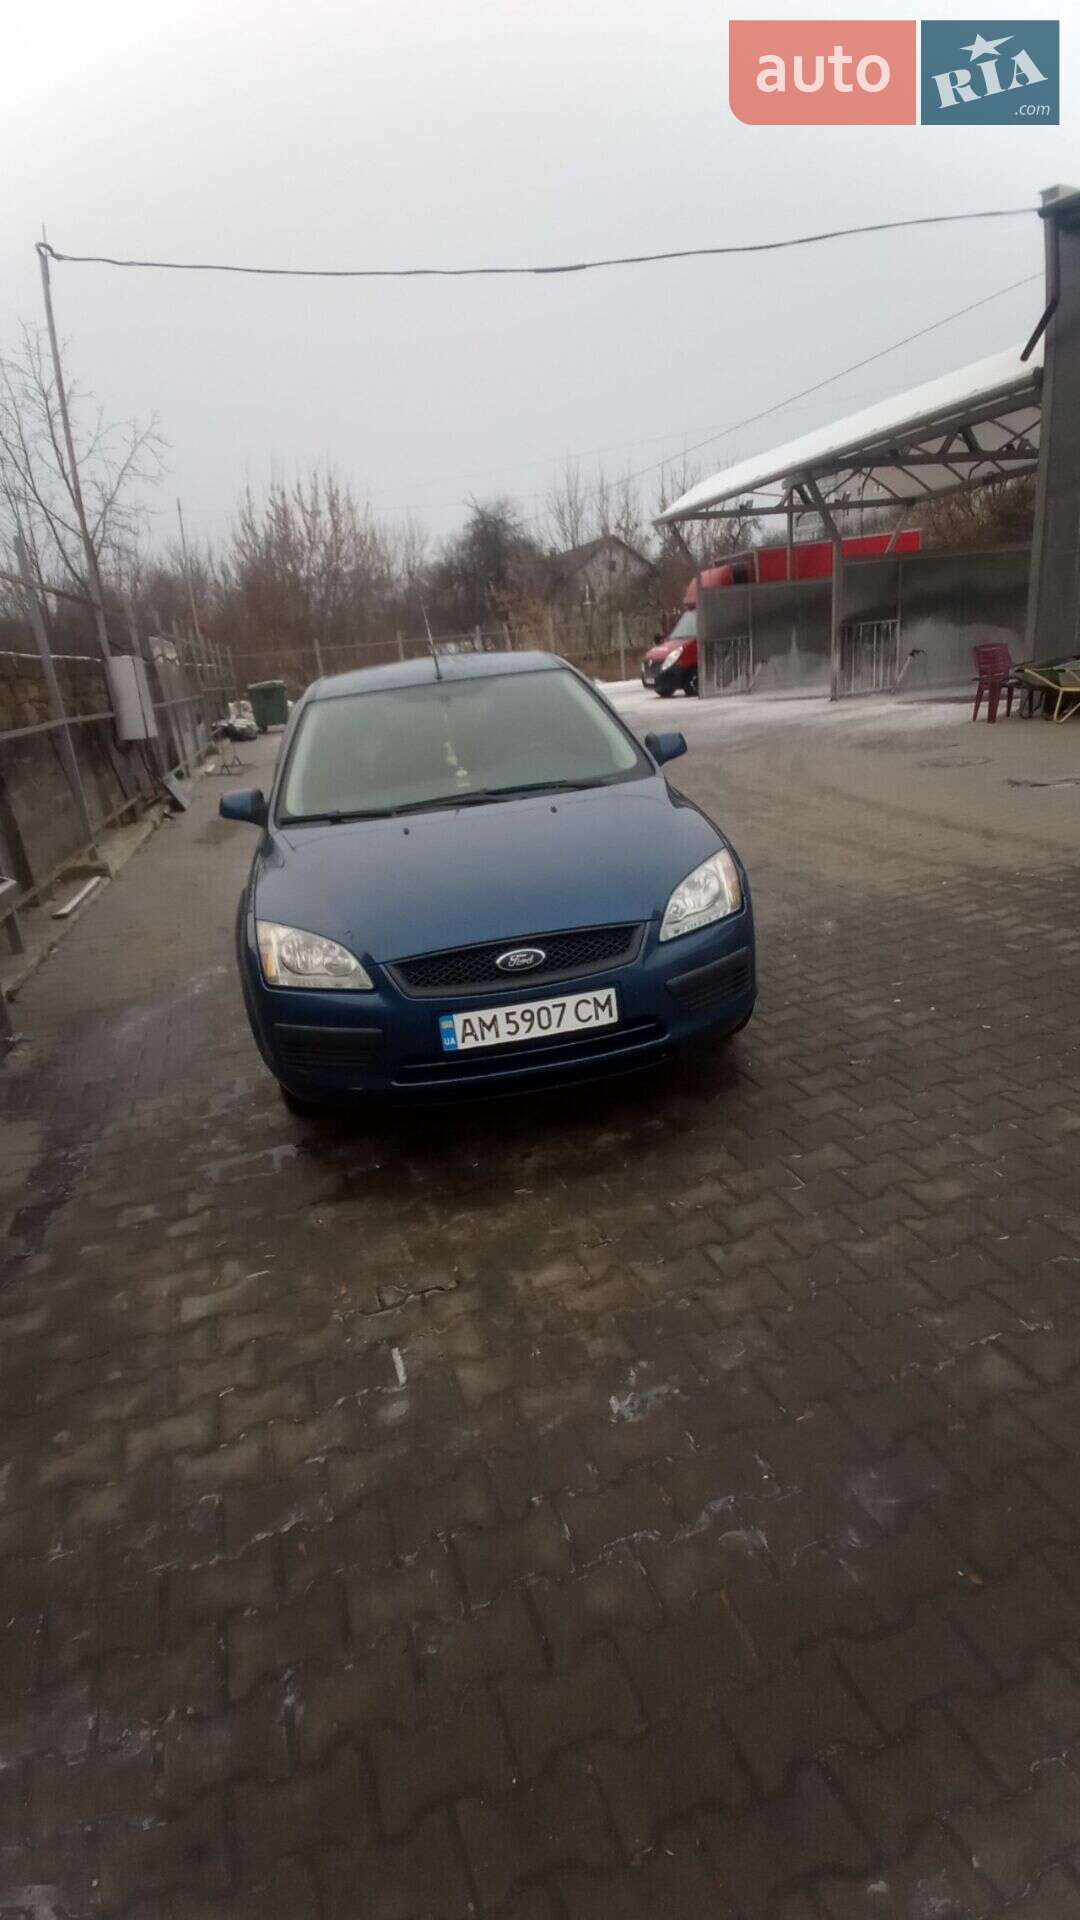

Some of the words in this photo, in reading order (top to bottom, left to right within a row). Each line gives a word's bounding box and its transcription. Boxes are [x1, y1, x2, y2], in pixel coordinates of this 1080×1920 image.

[507, 953, 535, 967] Ford
[461, 1014, 501, 1044] AM
[505, 1002, 567, 1036] 5907
[574, 993, 614, 1024] CM
[443, 1037, 457, 1046] UA
